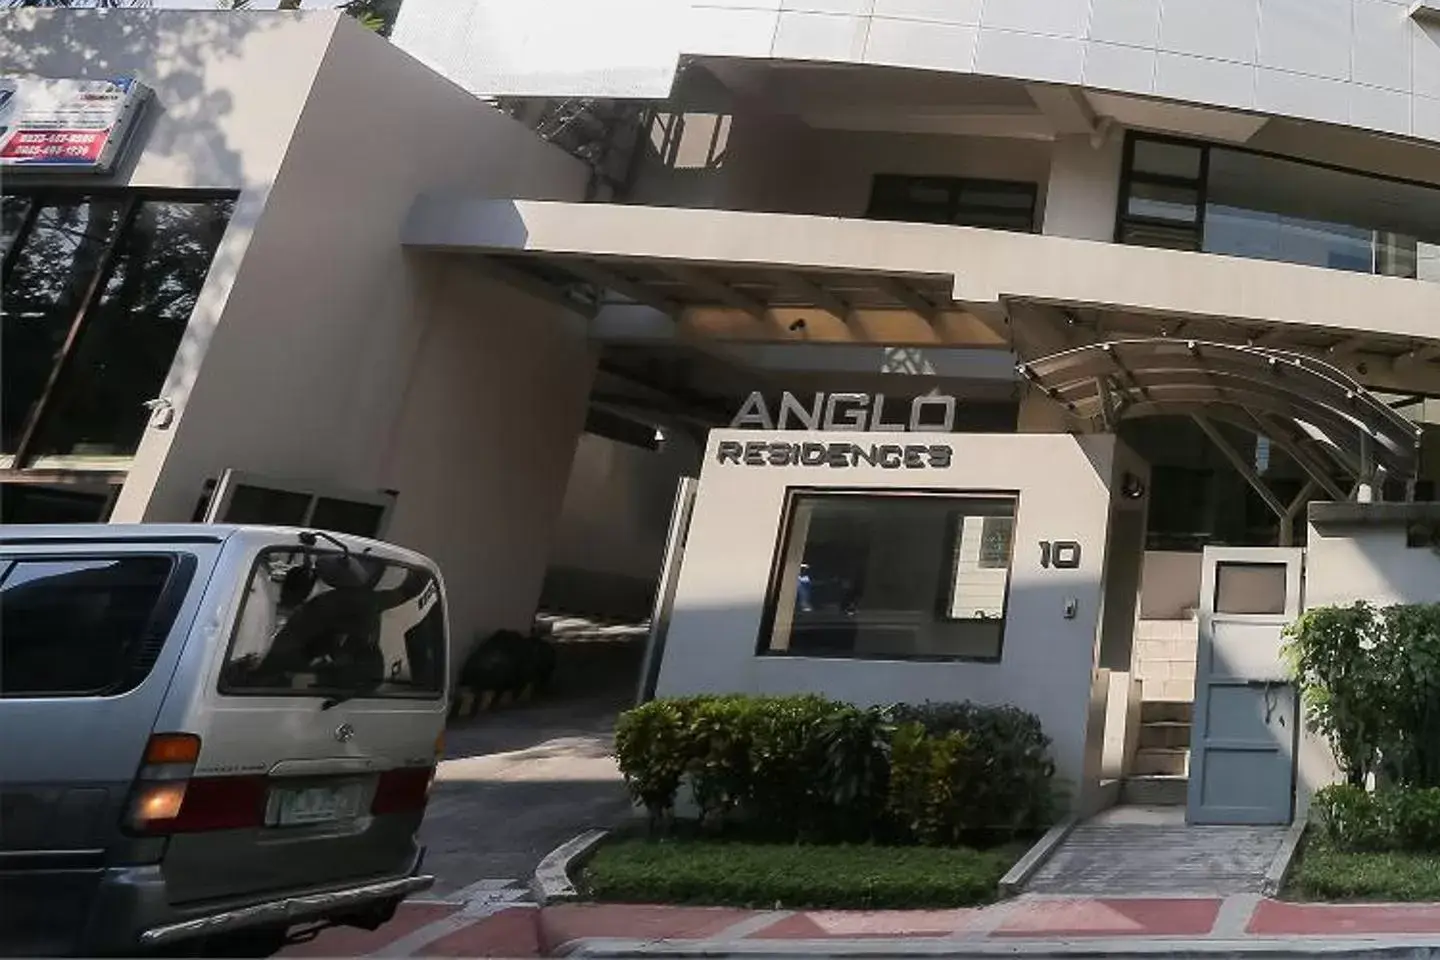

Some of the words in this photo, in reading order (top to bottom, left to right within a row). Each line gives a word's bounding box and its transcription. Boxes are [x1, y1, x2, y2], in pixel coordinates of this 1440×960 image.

[730, 390, 956, 432] ANGLO
[716, 441, 953, 469] RESIDENCES
[1038, 540, 1082, 570] 10
